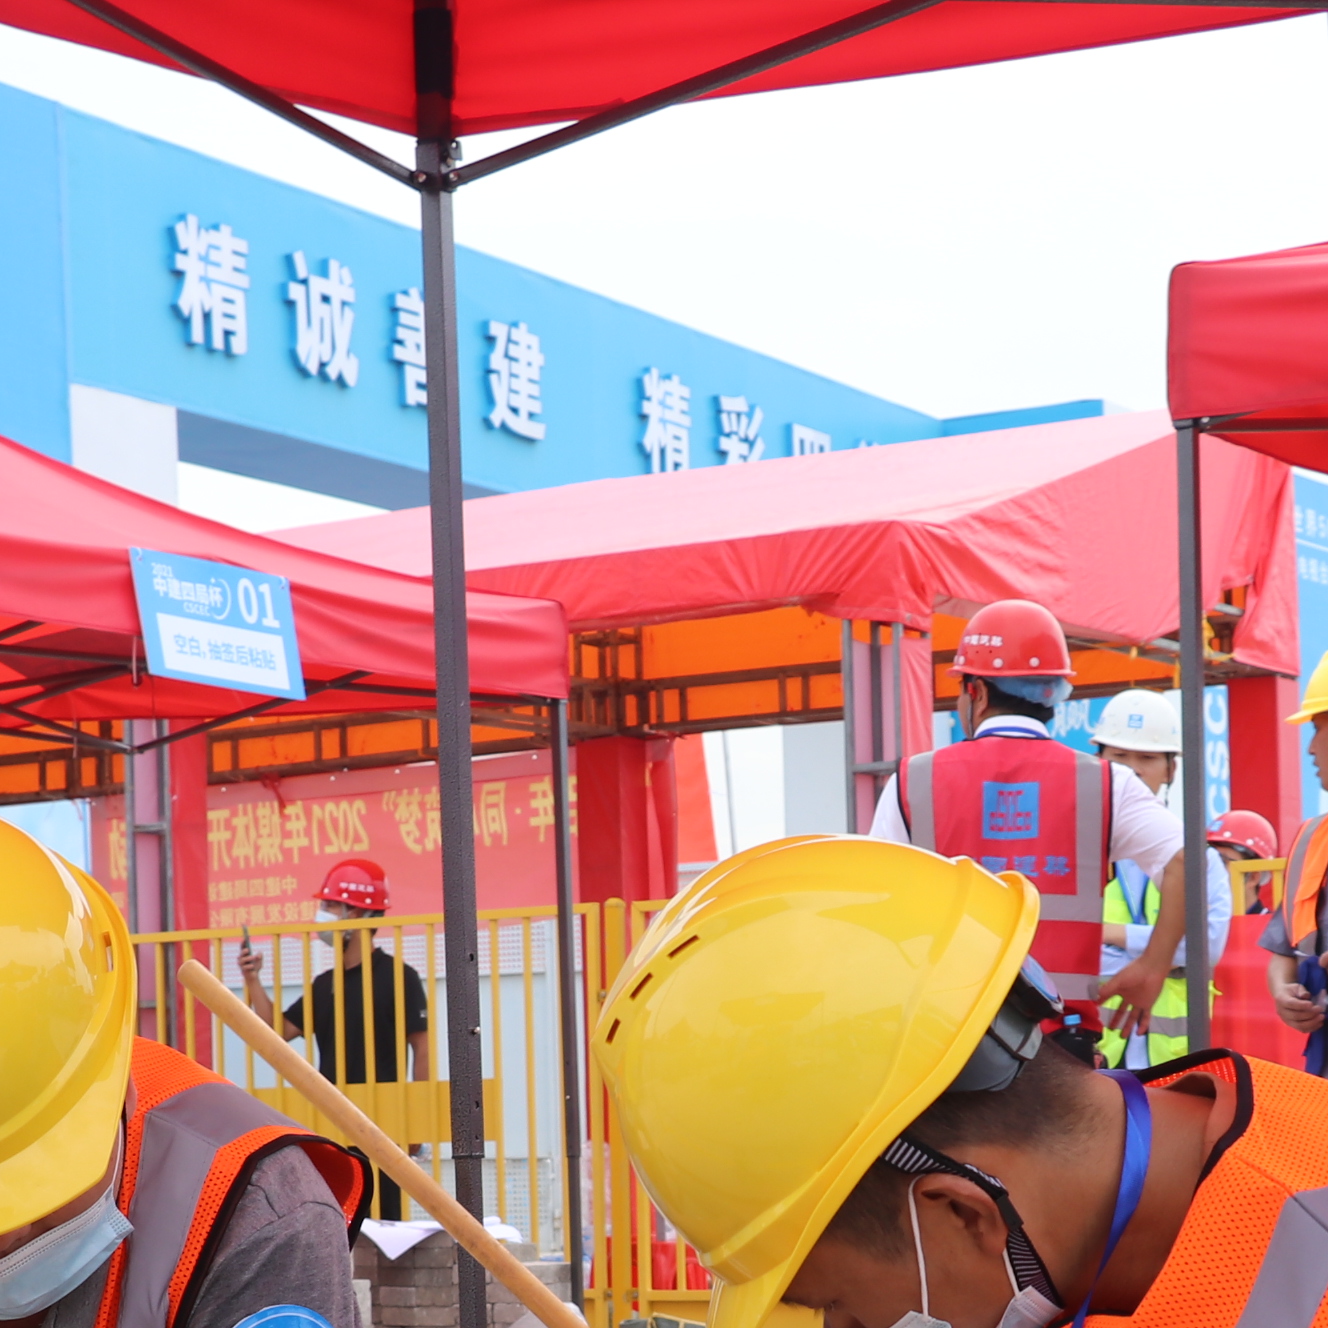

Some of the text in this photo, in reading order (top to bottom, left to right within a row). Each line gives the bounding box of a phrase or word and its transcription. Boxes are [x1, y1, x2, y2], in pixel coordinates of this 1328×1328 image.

[151, 562, 174, 578] 2021
[153, 576, 224, 608] 中建四局杯
[237, 577, 281, 628] 01
[183, 602, 212, 617] CSCEC
